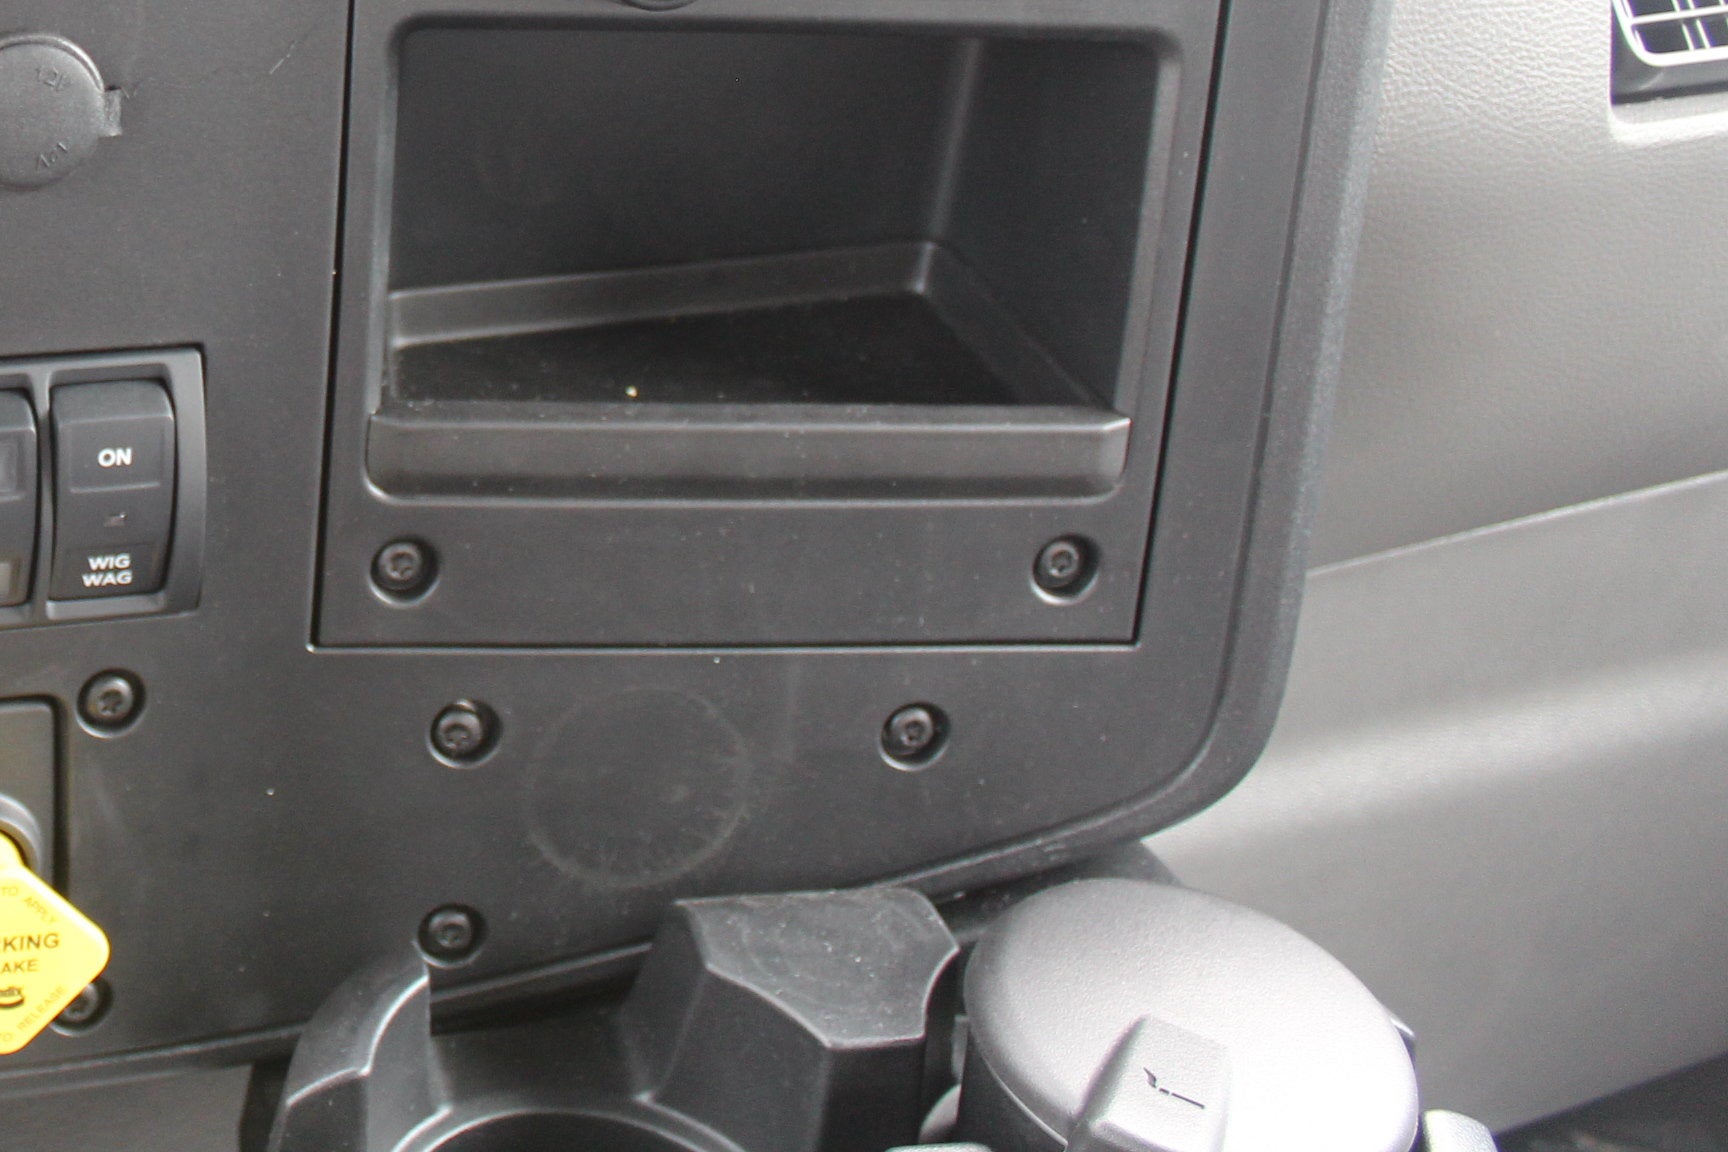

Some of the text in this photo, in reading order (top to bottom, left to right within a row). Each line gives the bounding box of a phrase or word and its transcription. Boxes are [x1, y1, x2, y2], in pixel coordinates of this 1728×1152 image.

[98, 448, 131, 466] ON
[89, 555, 130, 570] WIG
[83, 571, 132, 586] WAG
[0, 885, 19, 897] TO
[24, 896, 58, 925] APPLY
